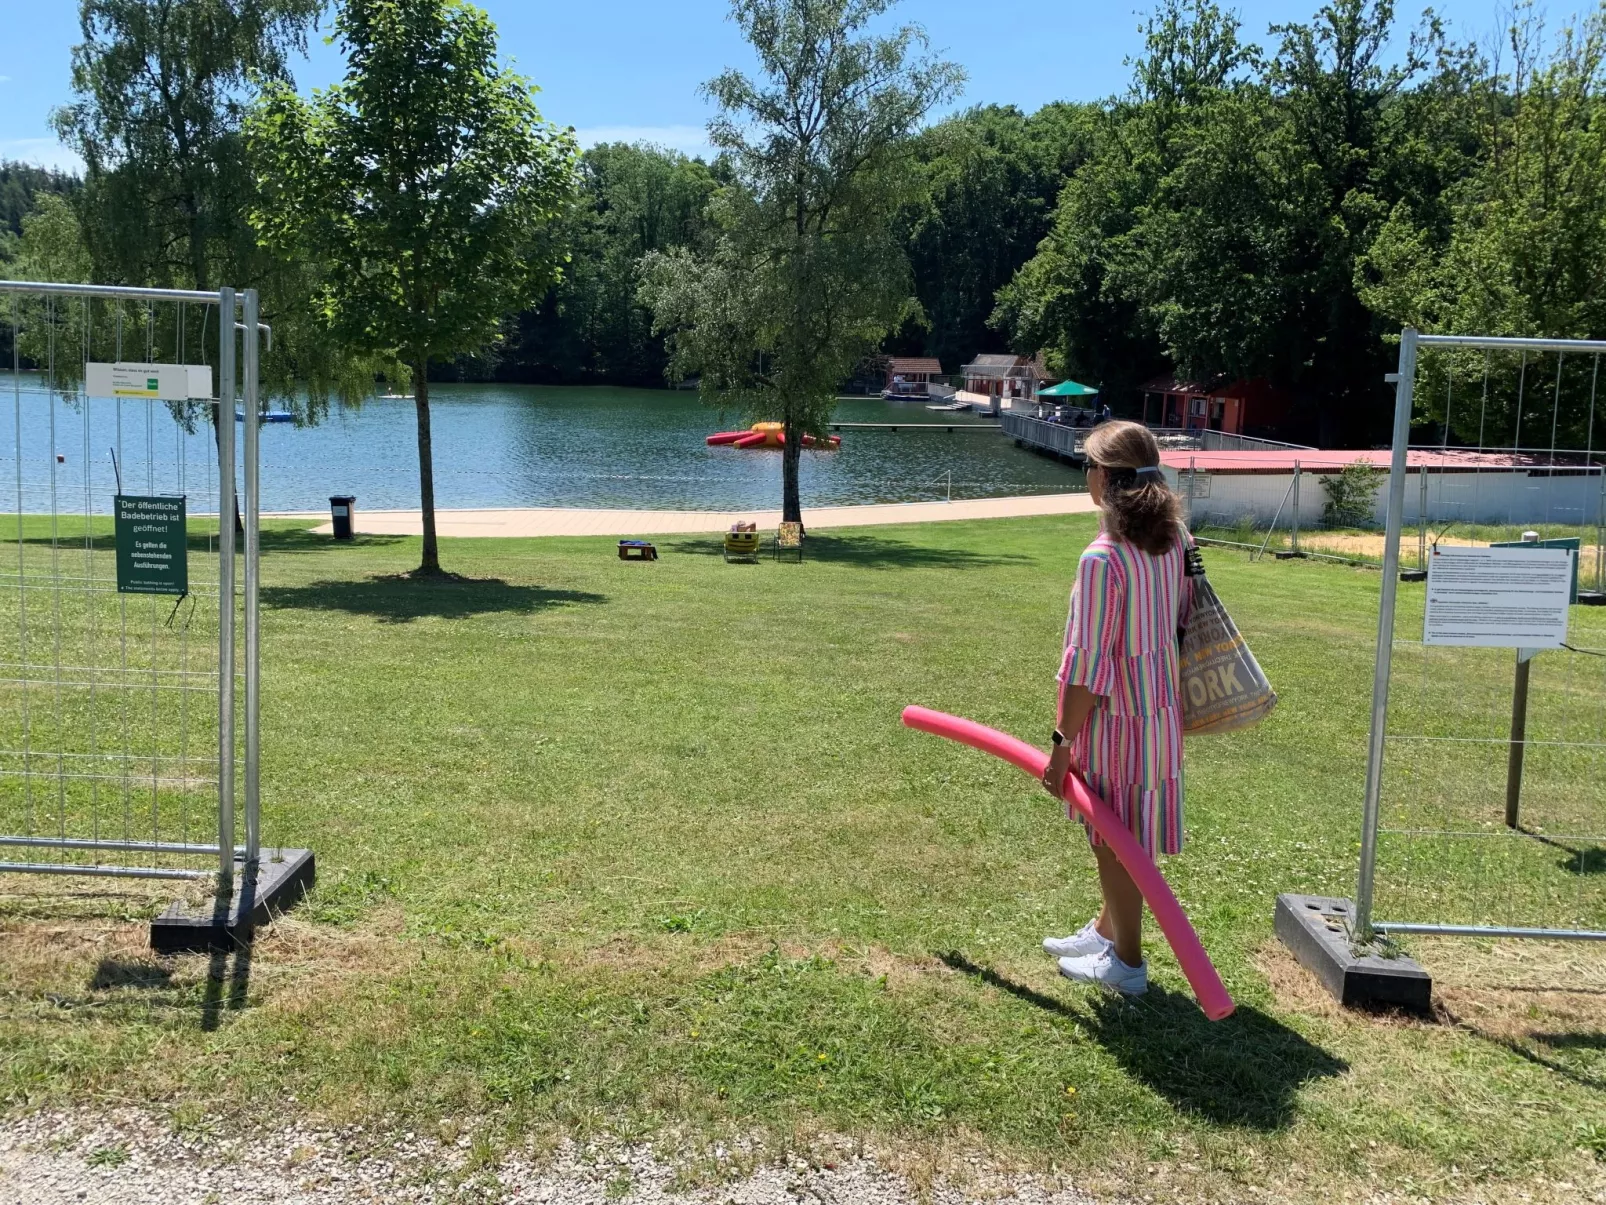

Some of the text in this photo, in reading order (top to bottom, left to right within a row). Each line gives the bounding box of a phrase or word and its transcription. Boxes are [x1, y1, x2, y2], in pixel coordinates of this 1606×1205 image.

[121, 500, 178, 511] Der öffentliche
[121, 511, 180, 521] Badebetrieb ist
[133, 524, 168, 533] geöffnet!
[135, 540, 142, 548] Es
[142, 541, 158, 549] gelten
[131, 551, 172, 560] nebenstehenden
[133, 561, 170, 571] Ausführungen.
